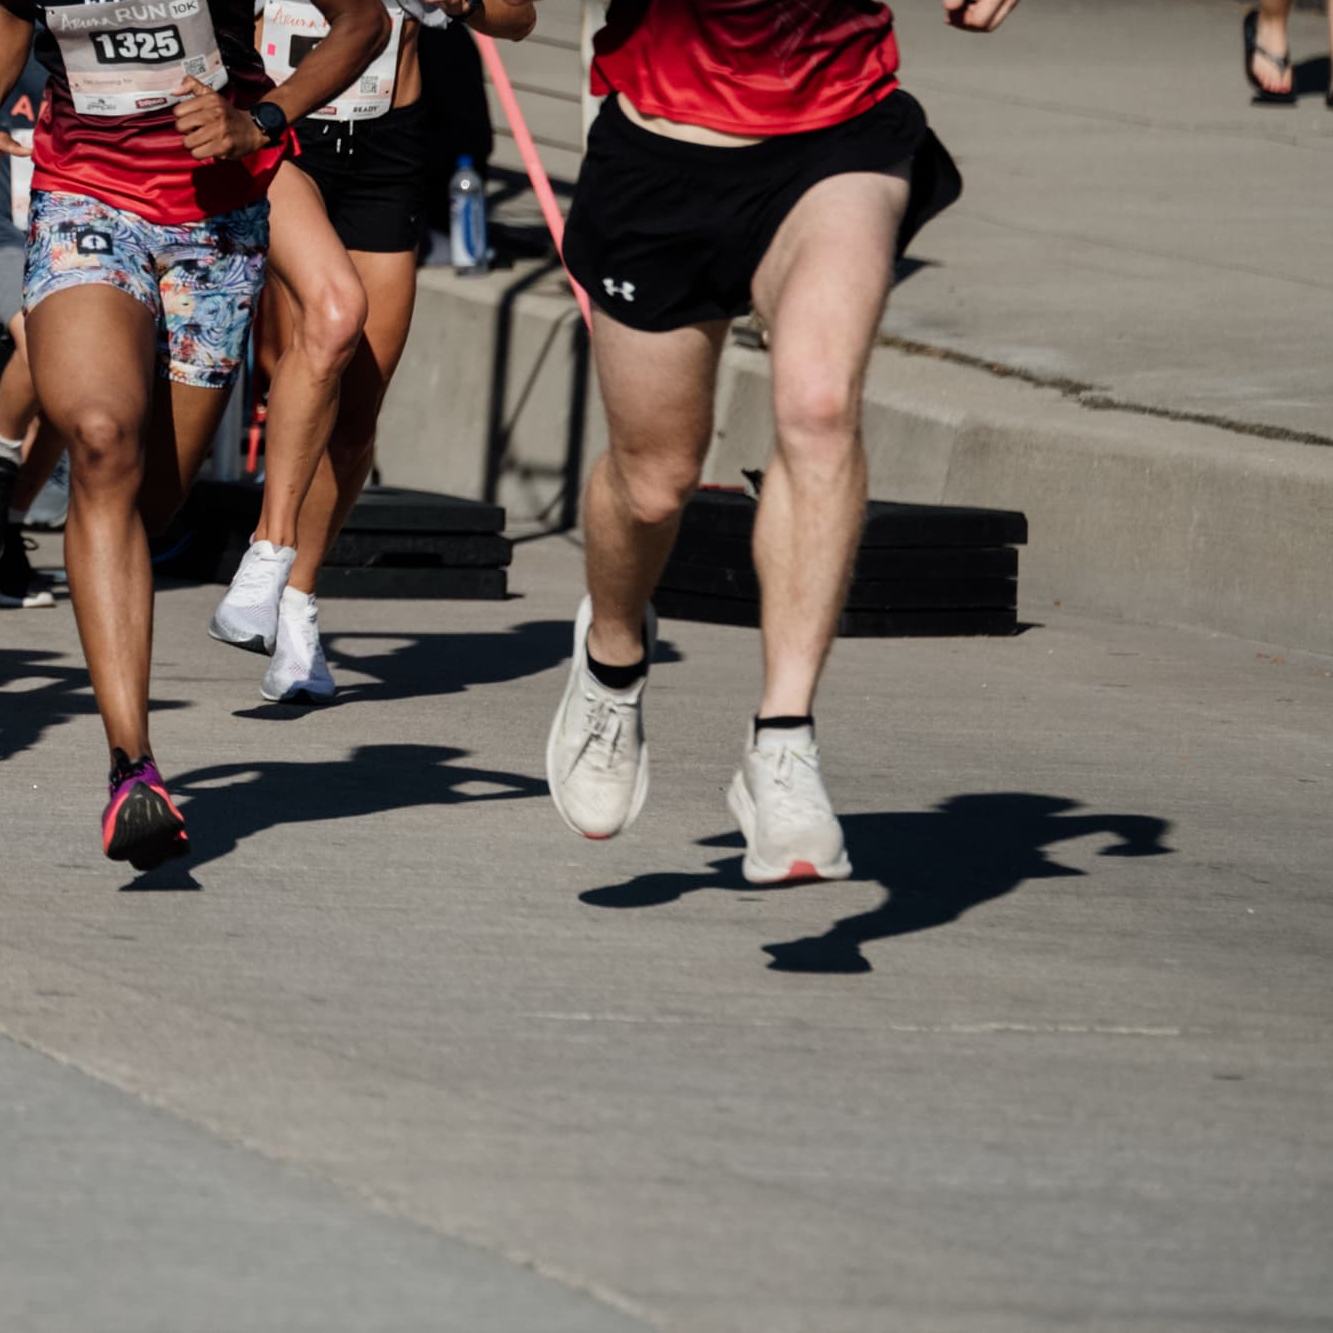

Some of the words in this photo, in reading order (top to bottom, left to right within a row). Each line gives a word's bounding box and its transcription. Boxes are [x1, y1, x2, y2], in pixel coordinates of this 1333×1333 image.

[114, 3, 167, 22] RUN
[172, 0, 198, 14] 10K
[96, 30, 180, 59] 1325
